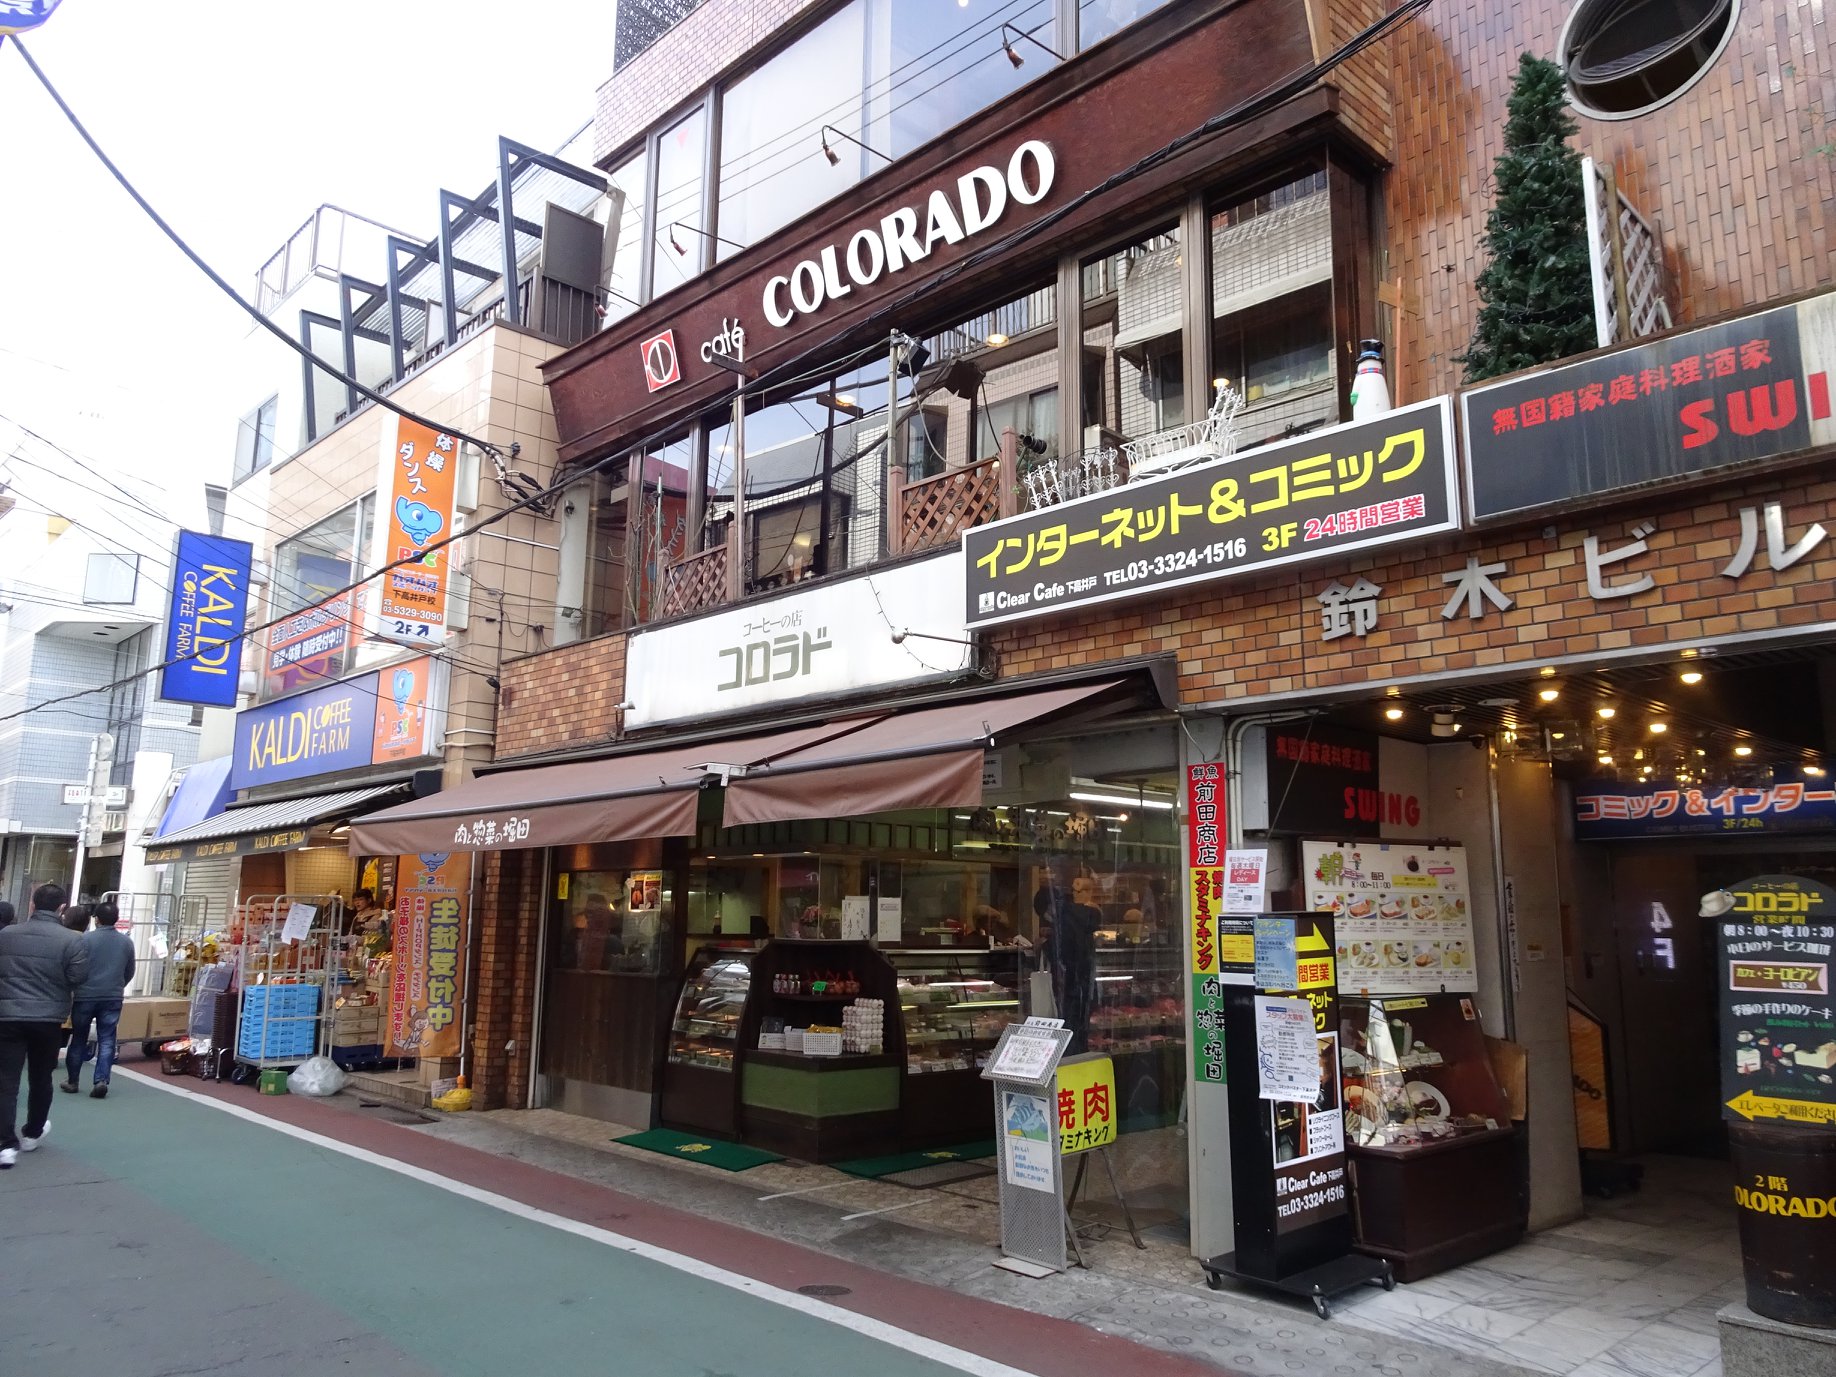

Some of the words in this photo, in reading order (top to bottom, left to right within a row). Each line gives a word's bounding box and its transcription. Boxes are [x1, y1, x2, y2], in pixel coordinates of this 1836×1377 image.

[701, 317, 745, 363] café
[763, 140, 1055, 327] COLORADO
[1491, 339, 1772, 436] 無国籍家庭料理酒家
[399, 441, 428, 495] ダンス
[977, 428, 1426, 579] インターネット&コミック
[997, 590, 1031, 609] Clear
[1033, 582, 1065, 601] Cafe
[1066, 575, 1098, 595] 下高井戸
[1262, 522, 1298, 552] 3F
[1303, 493, 1426, 542] 24時間営業
[180, 571, 198, 617] COFFEE
[392, 588, 437, 606] 下高井戸校
[191, 564, 238, 675] KALDI
[383, 604, 443, 623] 03-5329-3090
[394, 620, 413, 635] 2F
[743, 609, 804, 637] コーヒーの店
[176, 623, 192, 660] FARM
[718, 626, 833, 692] コロラド
[249, 708, 312, 771] KALDI
[314, 698, 353, 730] COFFEE
[311, 726, 350, 757] FARM
[1192, 766, 1219, 780] 鮮魚
[1195, 781, 1219, 865] 前田商店
[1344, 786, 1421, 827] SWING
[455, 817, 530, 846] 肉と惣菜の堀田
[1318, 850, 1344, 887] 朝
[1371, 872, 1385, 881] 毎日
[1733, 891, 1824, 912] コロラド
[1194, 870, 1213, 971] スタミナキング
[1288, 1176, 1309, 1193] Clear
[1310, 1170, 1327, 1187] Cafe
[1754, 1174, 1789, 1192] 2階
